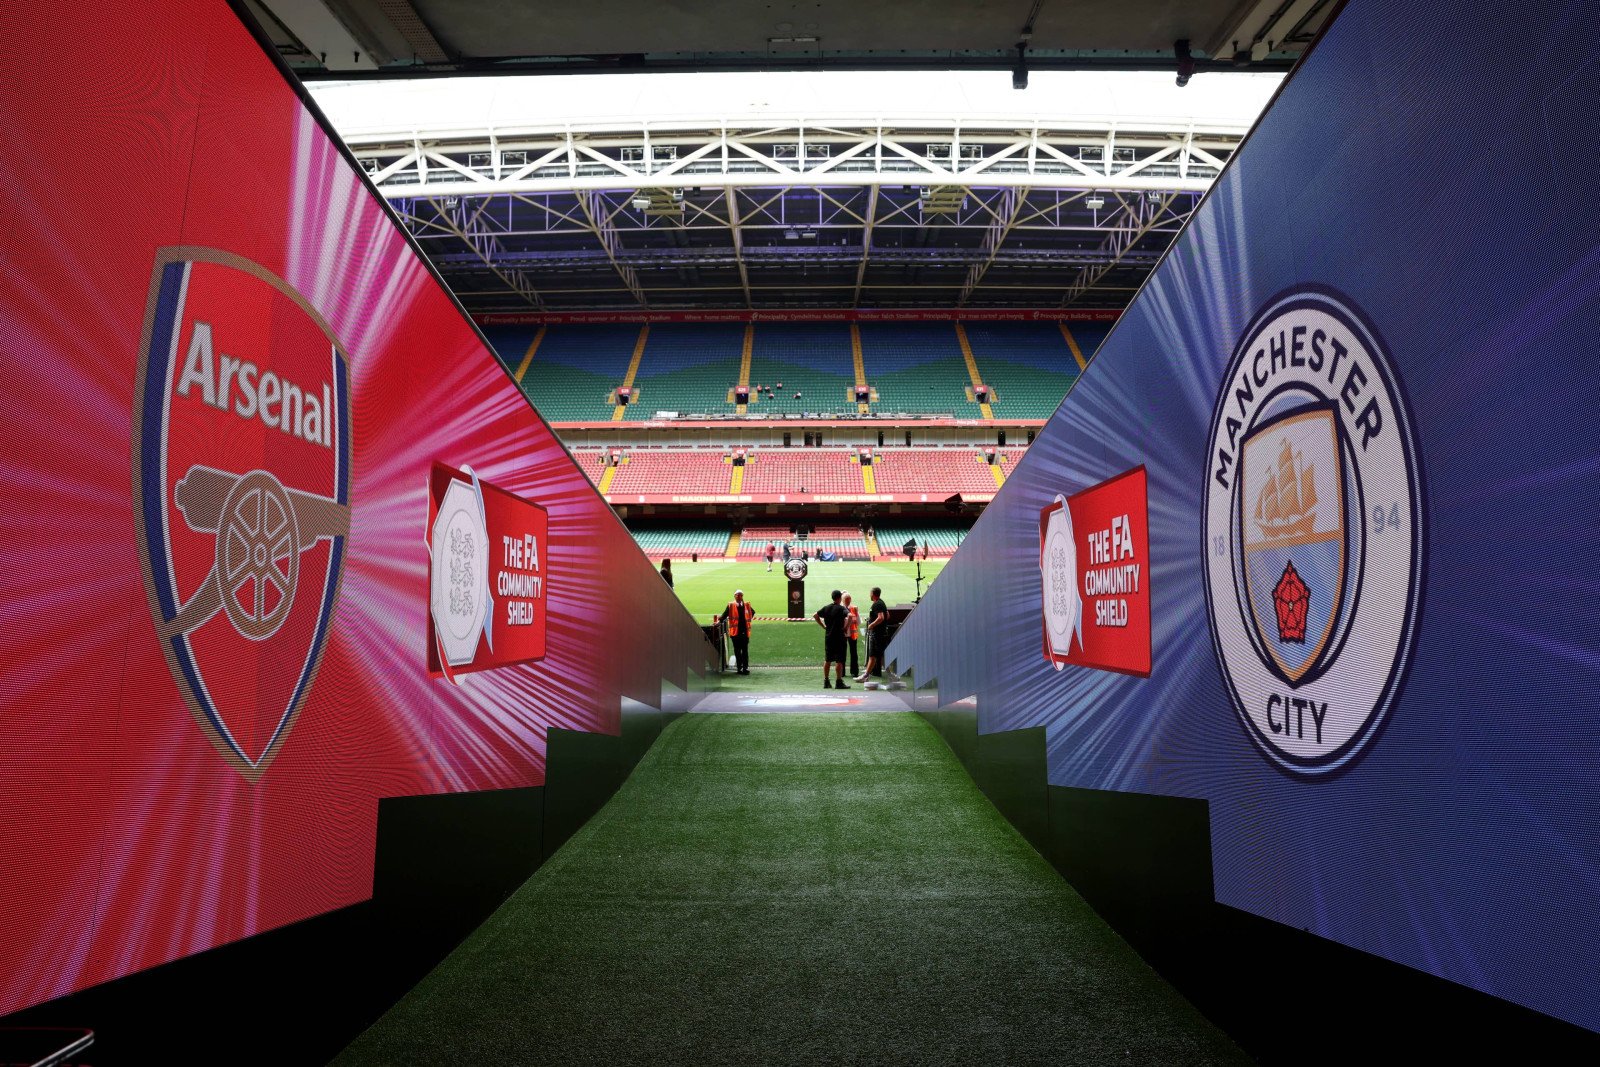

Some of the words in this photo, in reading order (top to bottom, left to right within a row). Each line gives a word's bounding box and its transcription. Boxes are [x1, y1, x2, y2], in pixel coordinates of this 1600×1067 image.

[758, 313, 788, 321] Principality
[923, 313, 952, 321] Principality
[1040, 313, 1069, 321] Principality
[1095, 313, 1114, 321] Society
[176, 320, 332, 448] Arsenal
[1215, 325, 1383, 490] MANCHESTER
[1372, 503, 1401, 534] 94
[503, 535, 523, 569] THE
[524, 533, 539, 572] FA
[1088, 529, 1110, 565] THE
[1112, 514, 1134, 561] FA
[1213, 535, 1225, 557] 18
[497, 570, 542, 598] COMMUNITY
[1085, 564, 1140, 596] COMMUNITY
[507, 600, 534, 625] SHIELD
[1095, 599, 1128, 627] SHIELD
[1266, 693, 1328, 744] CITY
